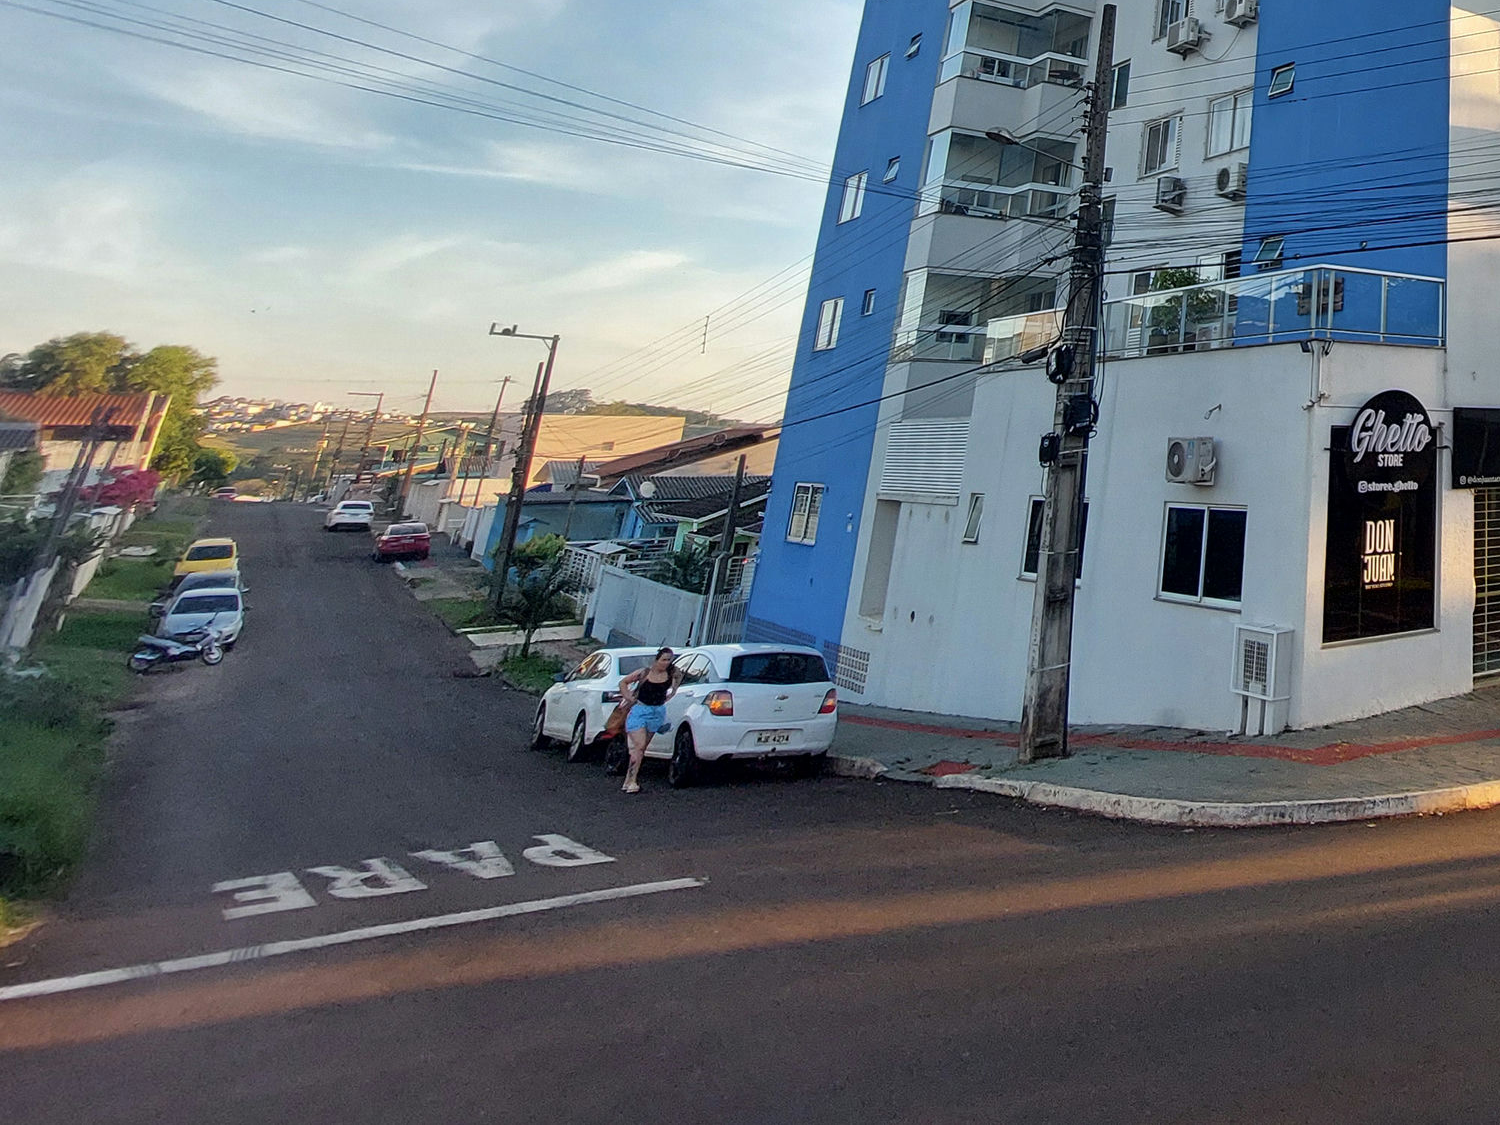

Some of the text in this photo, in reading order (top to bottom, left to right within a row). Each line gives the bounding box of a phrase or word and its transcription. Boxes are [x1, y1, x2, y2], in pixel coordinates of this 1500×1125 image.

[1352, 408, 1432, 463] Ghetto
[1377, 454, 1404, 467] STORE
[1365, 519, 1395, 554] DON
[212, 833, 618, 921] PARE
